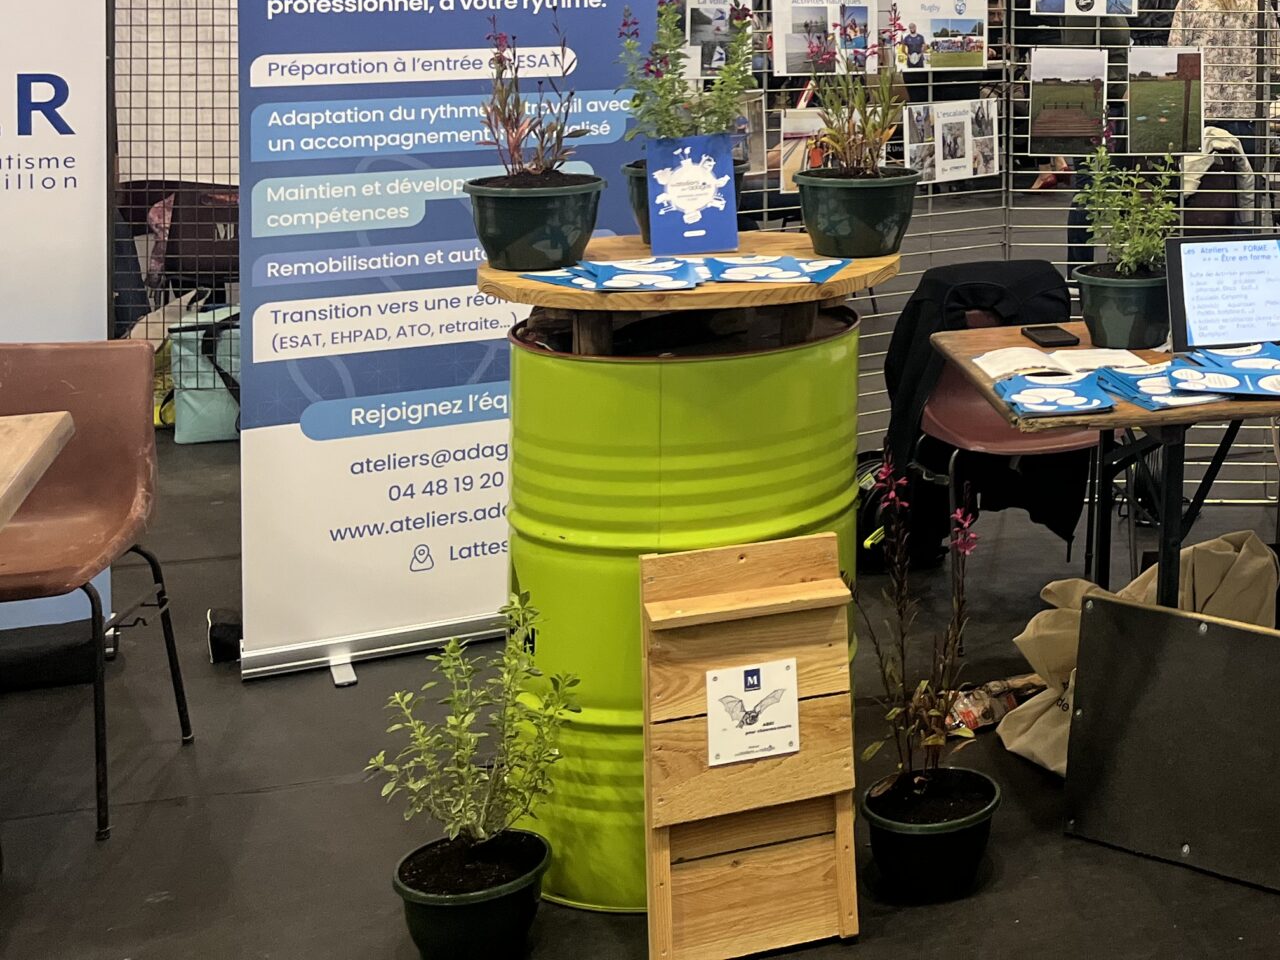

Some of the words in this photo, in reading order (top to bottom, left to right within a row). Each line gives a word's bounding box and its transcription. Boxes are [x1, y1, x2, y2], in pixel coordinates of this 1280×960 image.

[268, 57, 388, 81] Préparation
[393, 56, 407, 73] à
[411, 54, 484, 72] l'entrée
[517, 54, 561, 69] ESAT
[268, 106, 384, 130] Adaptation
[388, 104, 415, 122] du
[420, 101, 489, 128] rythme
[586, 100, 630, 112] avec
[268, 136, 295, 153] un
[300, 126, 490, 151] accompagnement
[0, 154, 76, 170] tisme
[5, 174, 77, 190] illon
[267, 180, 357, 202] Maintien
[361, 180, 382, 195] et
[386, 177, 468, 196] dévelop
[267, 204, 409, 229] compétences
[267, 252, 420, 278] Remobilisation
[424, 249, 444, 264] et
[270, 303, 373, 325] Transition
[377, 299, 419, 316] vers
[424, 295, 461, 312] une
[272, 330, 325, 353] (ESAT,
[330, 326, 392, 345] EHPAD,
[396, 322, 435, 340] ATO,
[351, 397, 463, 428] Rejoignez
[468, 392, 508, 415] l'éq
[350, 442, 508, 475] ateliers@adag
[388, 483, 415, 501] 04
[422, 478, 448, 496] 48
[454, 476, 474, 493] 19
[480, 471, 504, 490] 20
[449, 540, 508, 561] Lattes
